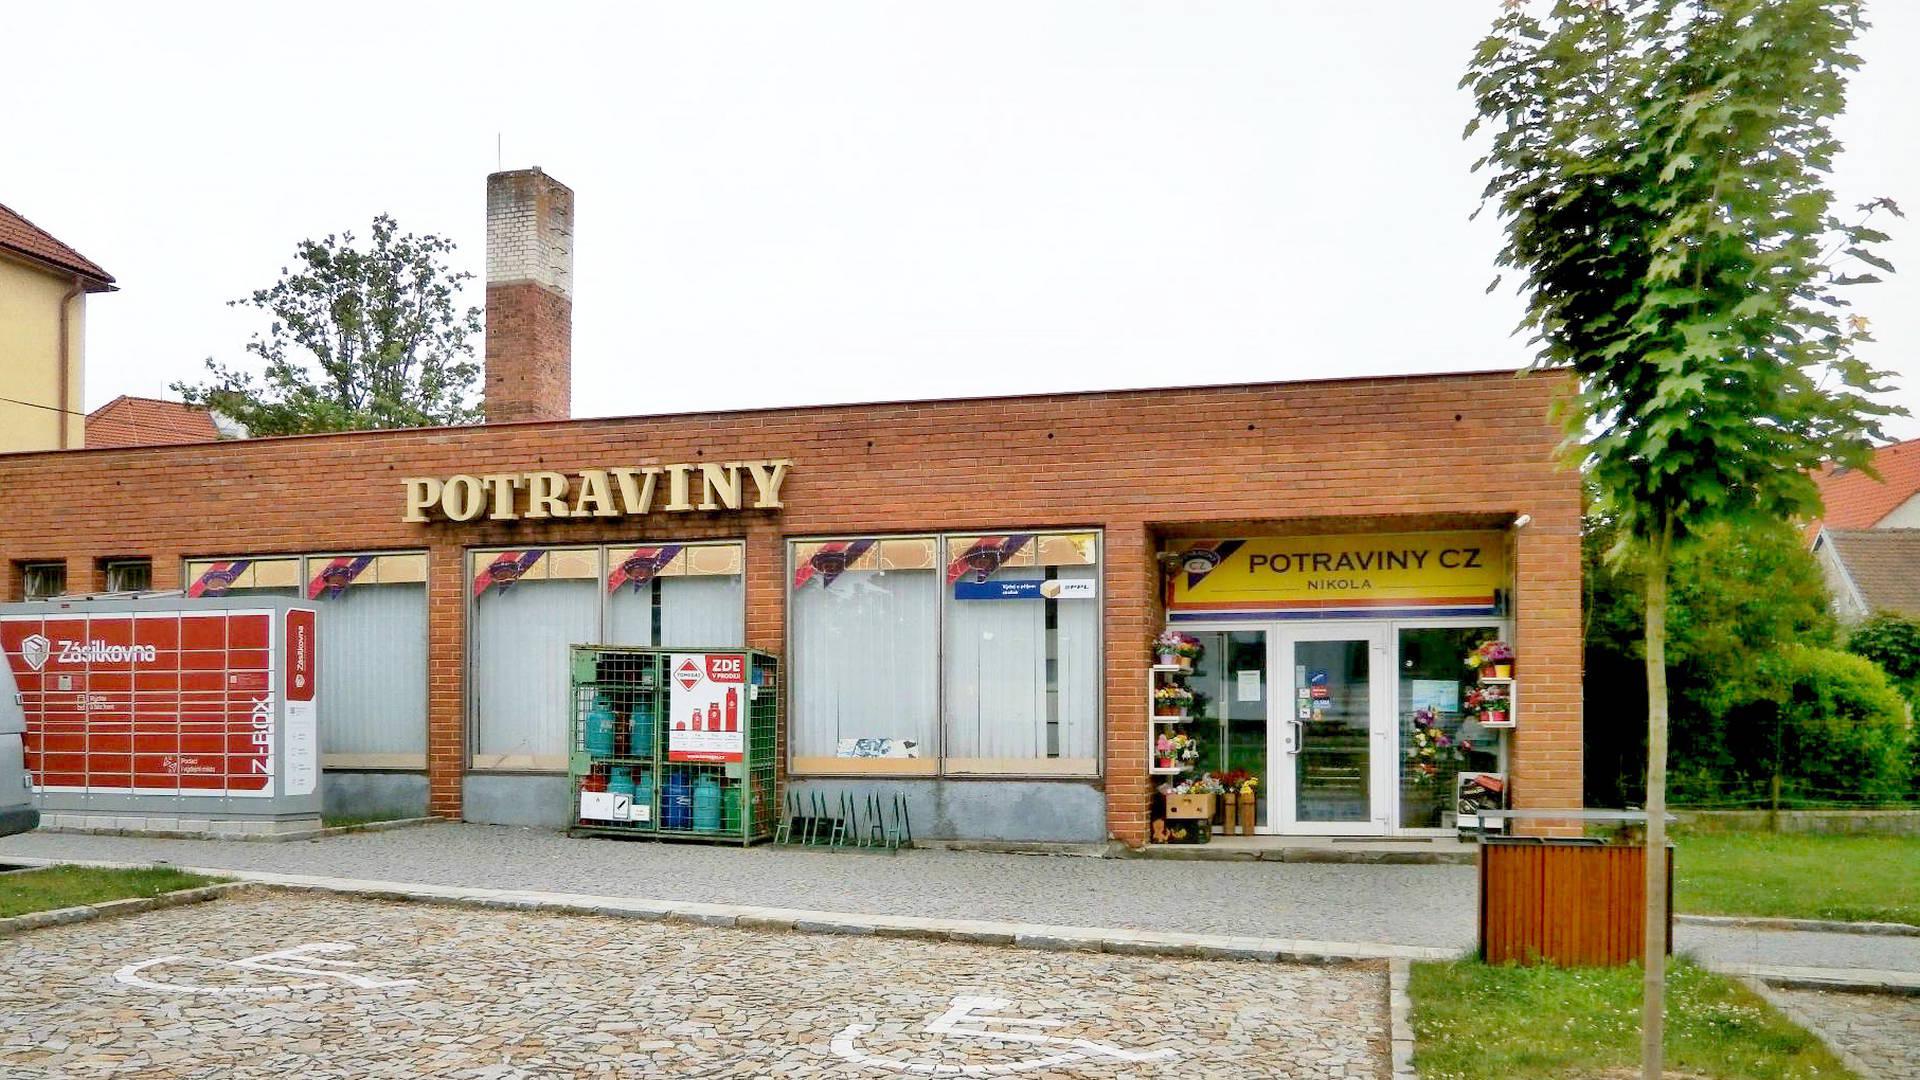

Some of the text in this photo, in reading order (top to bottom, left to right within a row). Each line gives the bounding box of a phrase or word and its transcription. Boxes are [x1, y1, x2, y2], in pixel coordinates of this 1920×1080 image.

[401, 459, 793, 523] POTRAVINY
[1249, 548, 1482, 573] POTRAVINY CZ
[1307, 579, 1373, 590] NIKOLA
[58, 640, 156, 662] Zásilkovna
[712, 659, 741, 672] ZDE
[252, 696, 270, 774] Z-BOX
